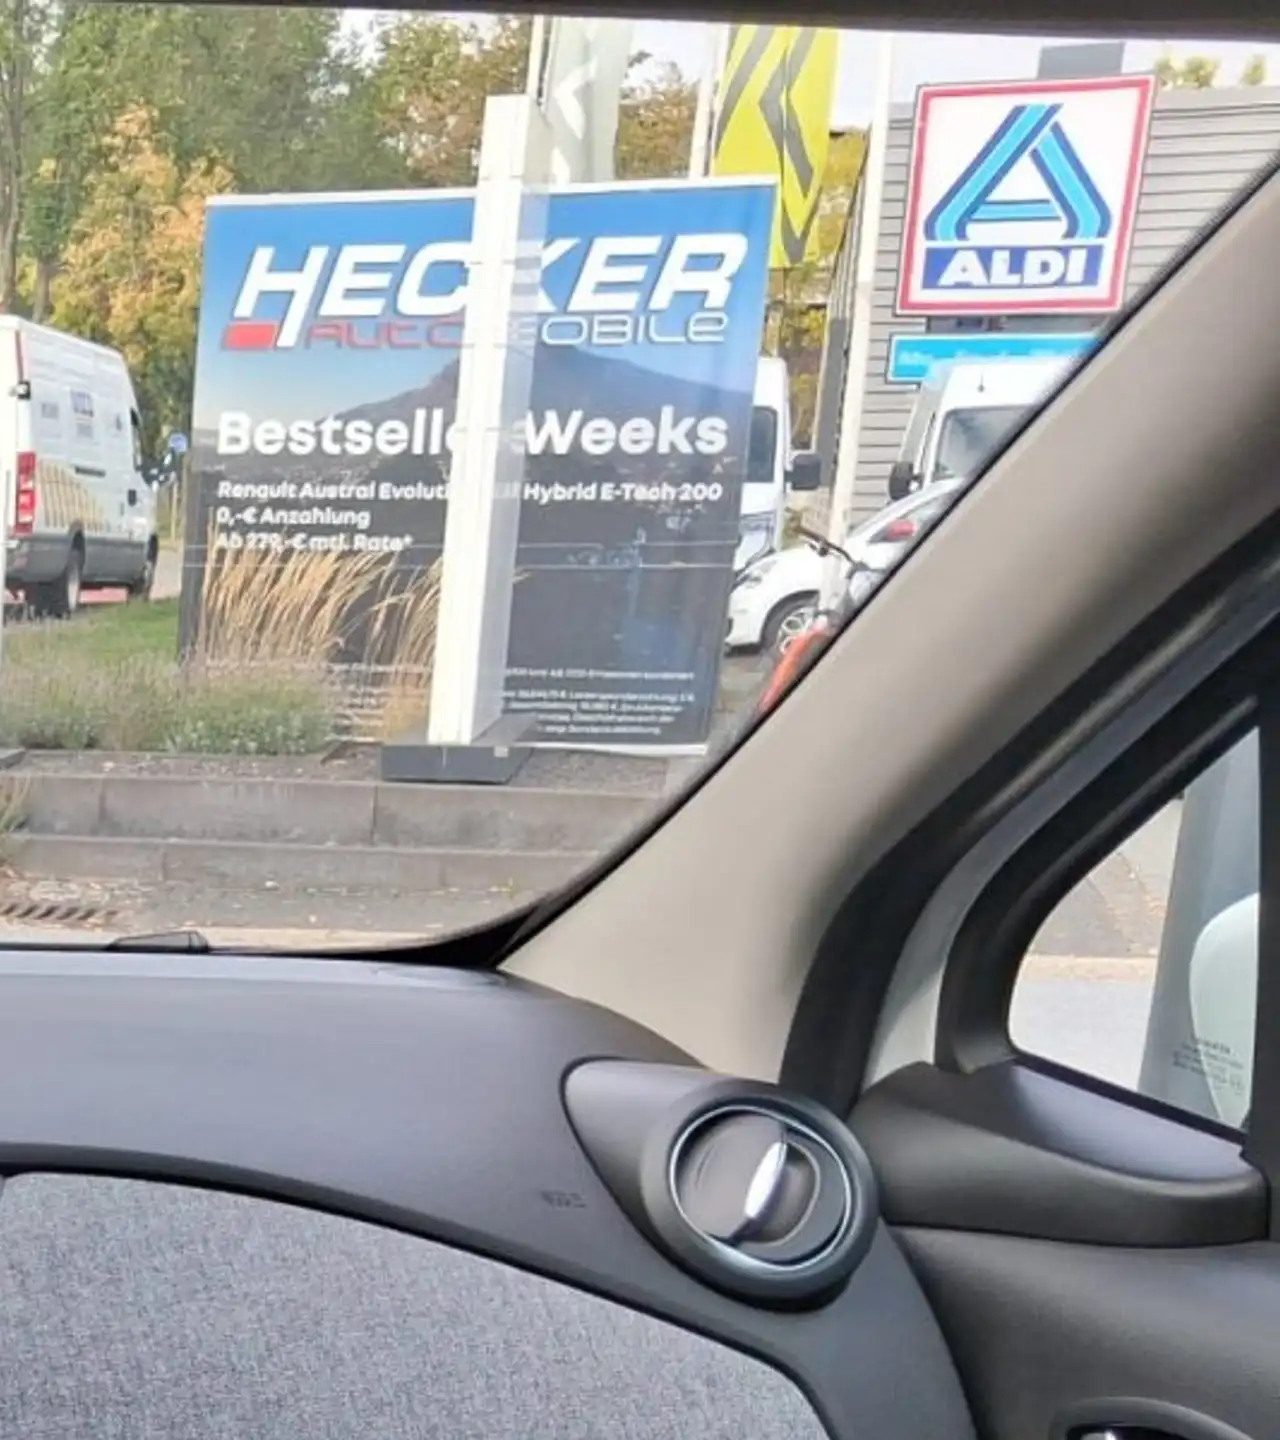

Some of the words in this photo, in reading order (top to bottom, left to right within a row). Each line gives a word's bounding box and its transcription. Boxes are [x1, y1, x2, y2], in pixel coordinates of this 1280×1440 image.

[937, 248, 1089, 286] ALDI
[217, 406, 459, 455] Bestsell
[524, 404, 729, 455] Weeks
[299, 481, 377, 500] Austral
[379, 481, 449, 500] Evolut
[523, 482, 596, 505] Hybrid
[678, 484, 723, 501] 200
[259, 507, 371, 529] Anzahlung
